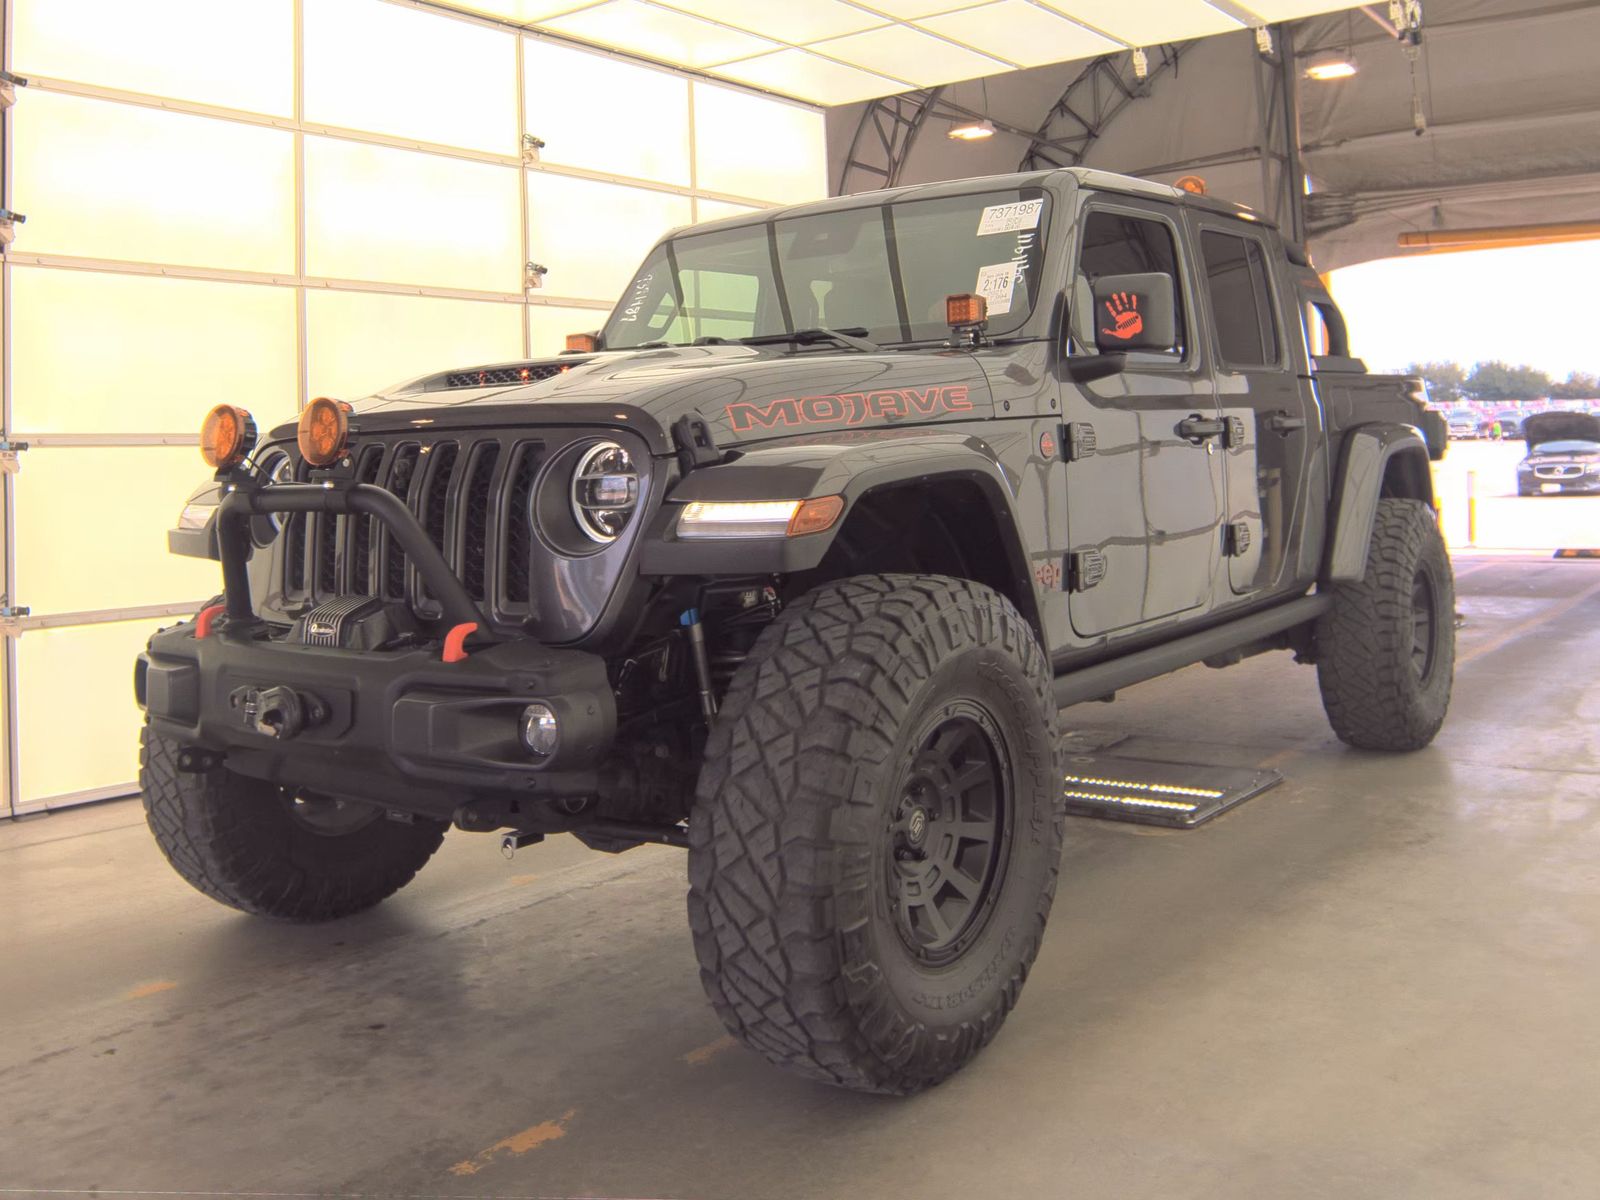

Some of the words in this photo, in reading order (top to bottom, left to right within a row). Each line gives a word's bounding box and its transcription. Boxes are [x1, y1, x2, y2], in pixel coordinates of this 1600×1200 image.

[989, 202, 1043, 220] 7371987
[726, 386, 973, 432] MOJAVE
[1034, 564, 1060, 592] eep
